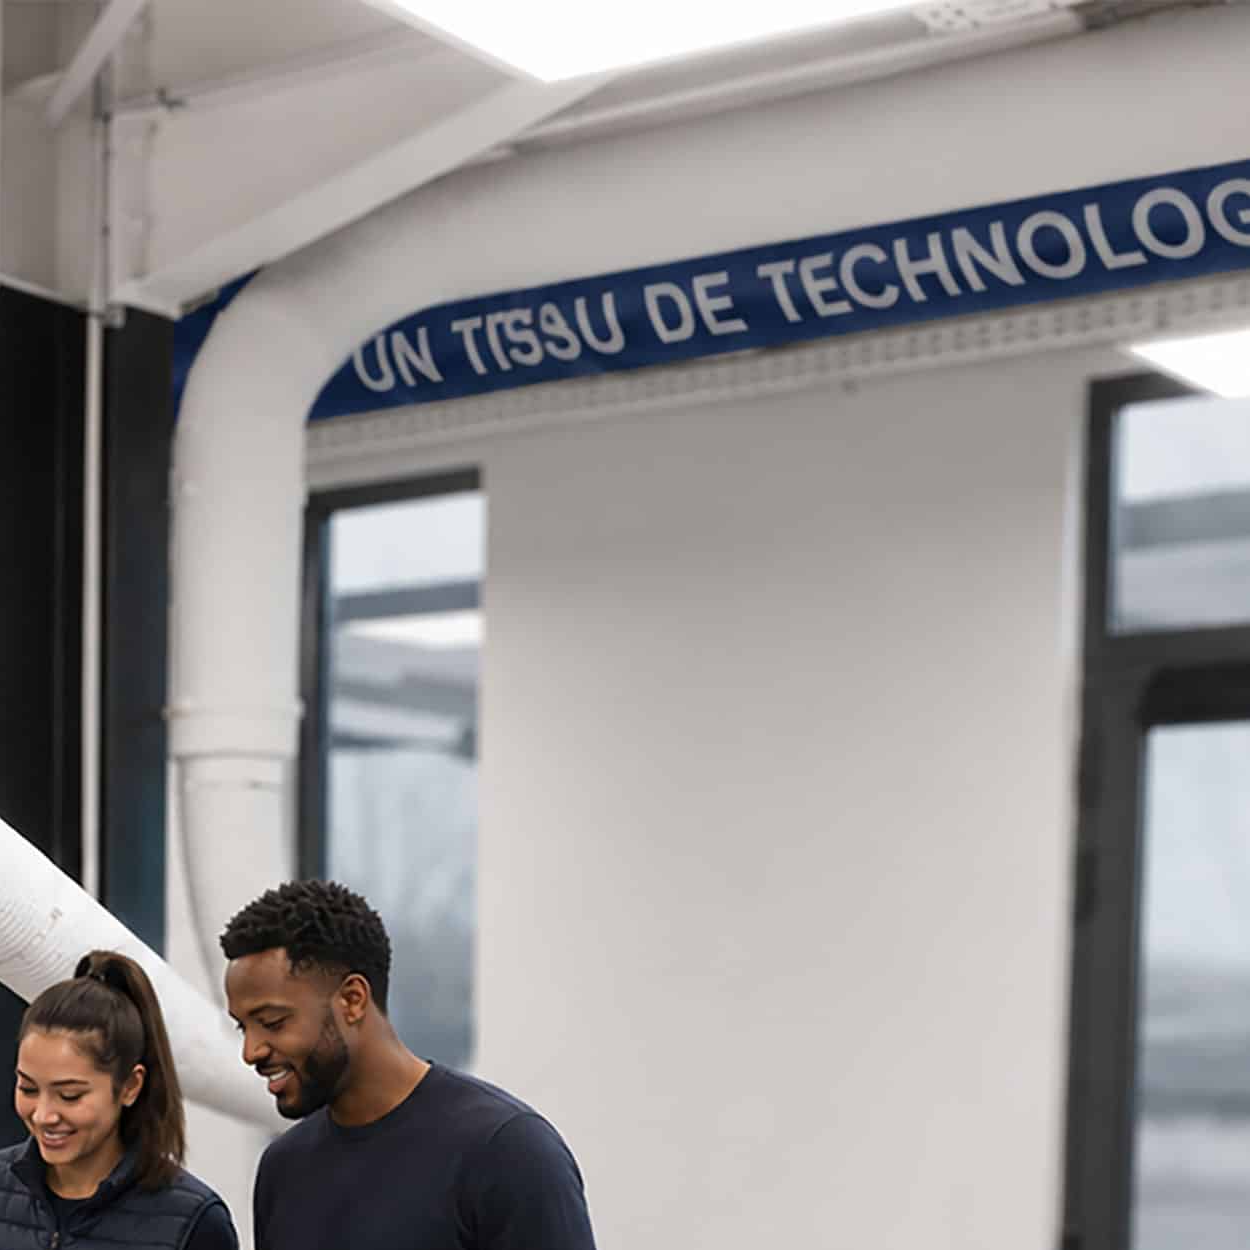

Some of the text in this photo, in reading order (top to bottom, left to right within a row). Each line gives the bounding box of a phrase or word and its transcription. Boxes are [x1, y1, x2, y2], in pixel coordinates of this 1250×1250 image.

[353, 177, 1250, 393] UN TISSU DE TECHNOLOG
